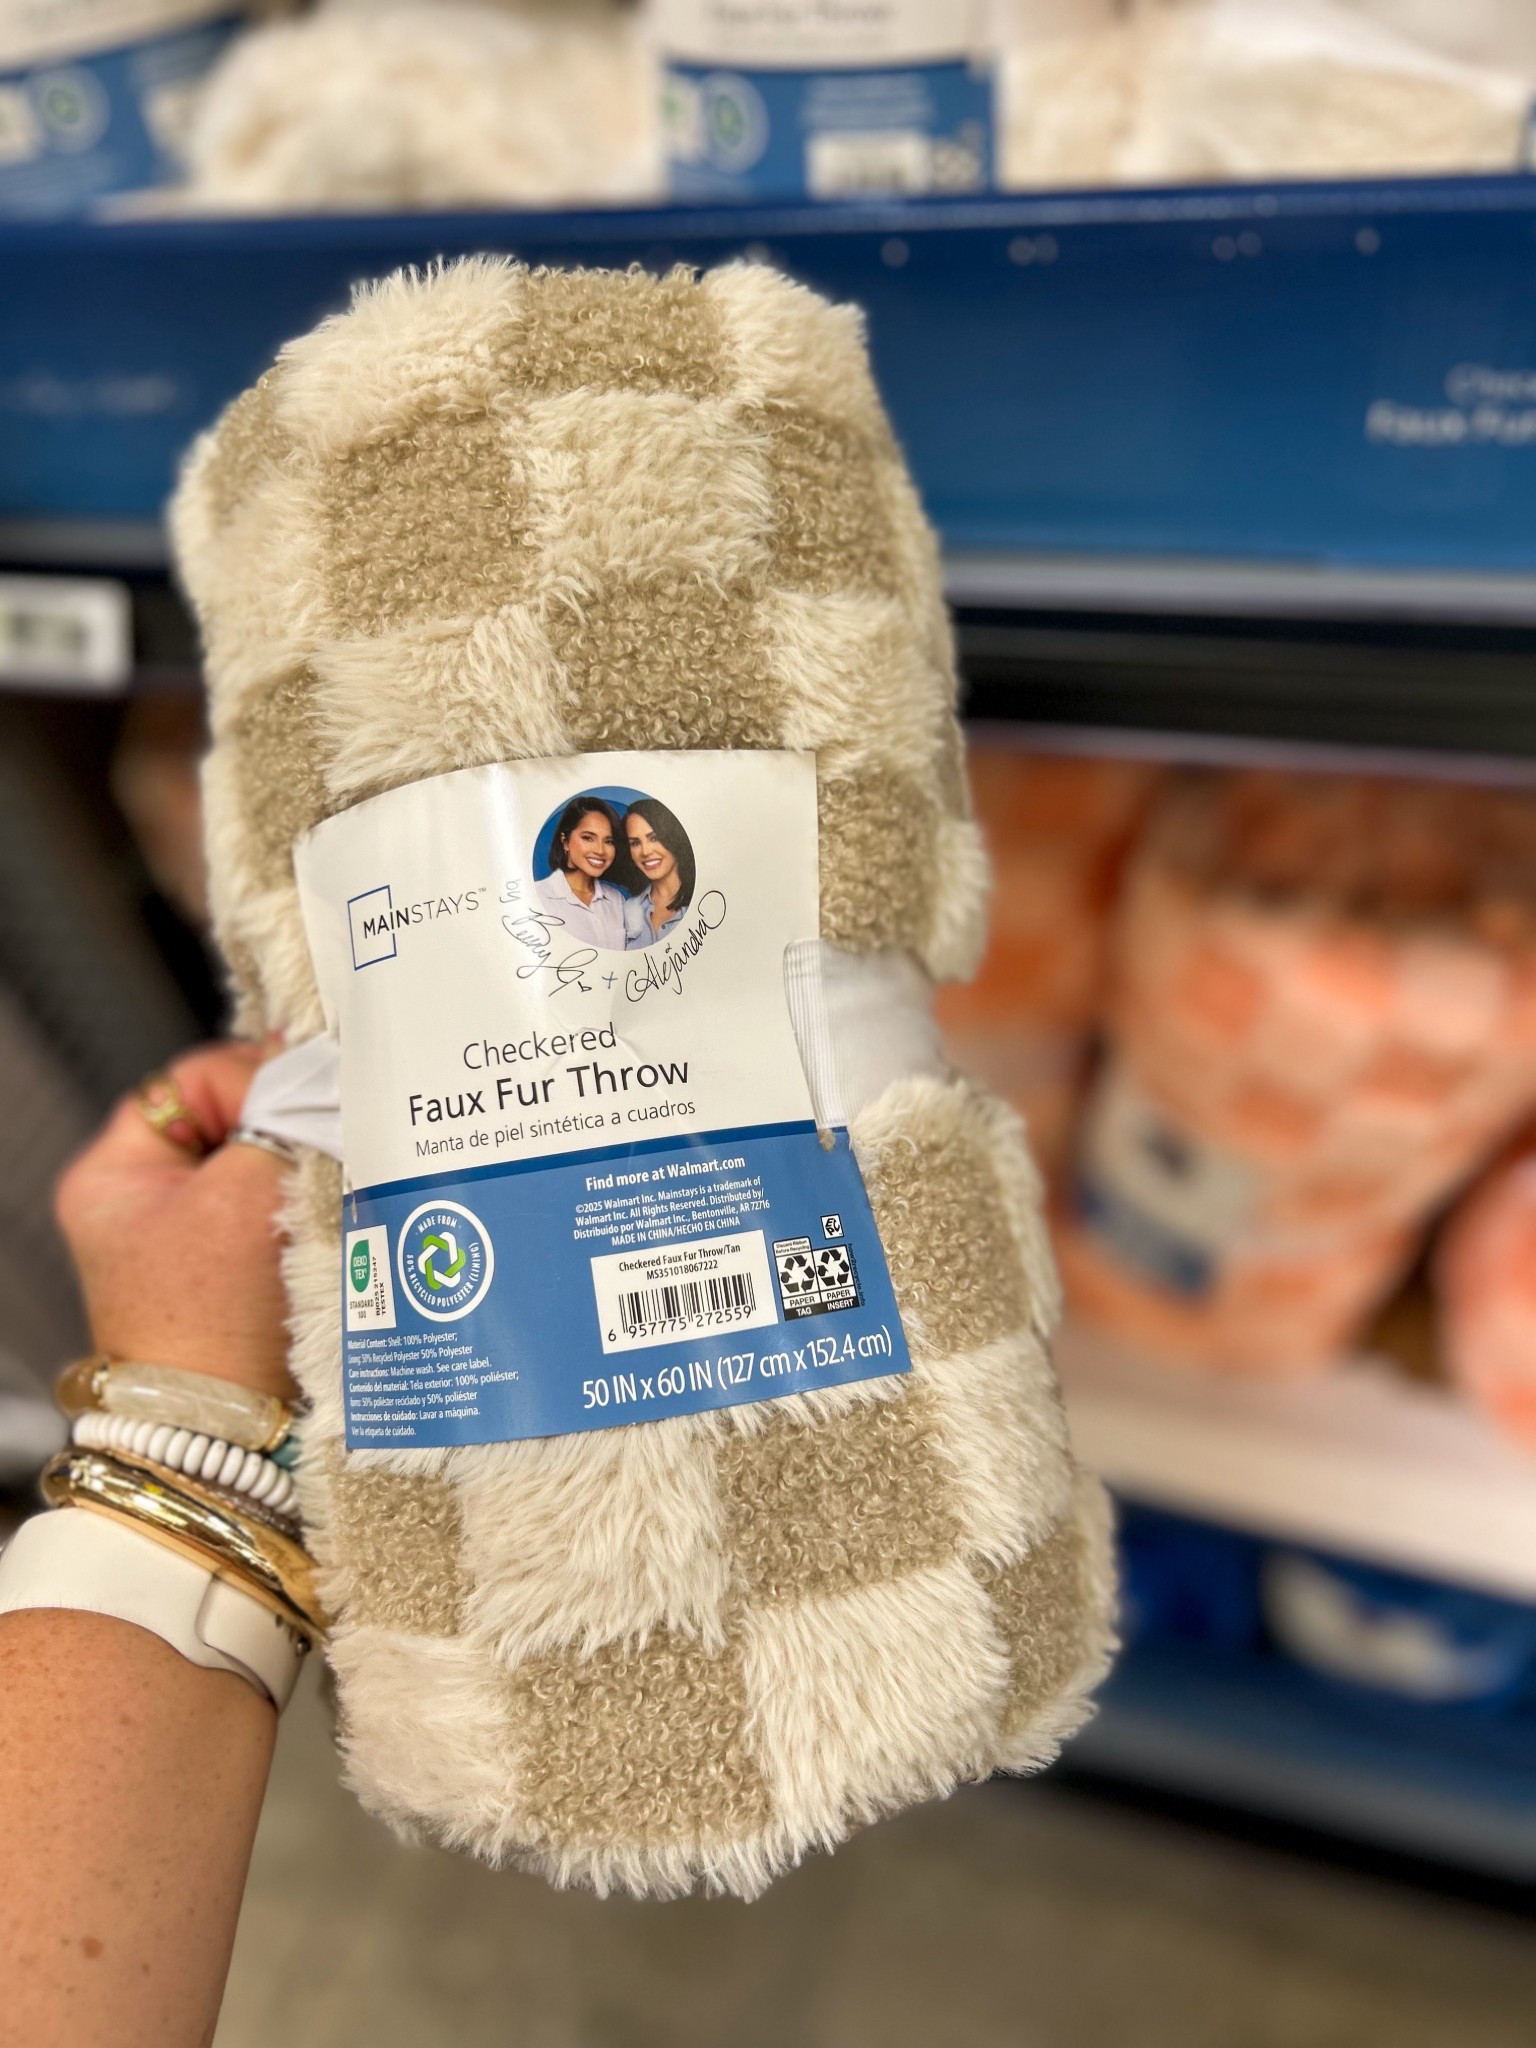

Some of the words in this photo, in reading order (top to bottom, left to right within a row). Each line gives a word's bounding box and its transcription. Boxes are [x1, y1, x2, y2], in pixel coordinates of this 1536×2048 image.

[625, 890, 726, 1002] Alejandra
[463, 1022, 616, 1069] Checkered
[409, 1090, 486, 1125] Faux
[496, 1076, 555, 1110] Fur
[567, 1061, 689, 1097] Throw
[416, 1137, 464, 1156] Manta
[469, 1130, 489, 1147] de
[495, 1123, 524, 1147] piel
[530, 1113, 604, 1138] sintética
[611, 1112, 621, 1124] a
[627, 1100, 696, 1122] cuadros
[586, 1174, 613, 1191] Find
[616, 1170, 649, 1187] more
[651, 1168, 665, 1180] at
[666, 1157, 745, 1178] Walmart.com
[575, 1202, 603, 1214] ©2025
[604, 1196, 640, 1209] Walmart
[641, 1194, 656, 1203] Inc.
[658, 1188, 699, 1202] Mainstays
[699, 1185, 706, 1194] is
[713, 1178, 752, 1192] trademark
[753, 1176, 761, 1186] of
[575, 1213, 612, 1227] Walmart
[613, 1211, 629, 1220] Inc.
[630, 1207, 641, 1217] All
[643, 1204, 668, 1217] Rights
[670, 1199, 708, 1211] Reserved.
[710, 1191, 751, 1205] Distributed
[753, 1188, 764, 1199] by/
[418, 1216, 436, 1233] MADE
[437, 1215, 457, 1228] FROM
[573, 1225, 619, 1239] Distribuido
[621, 1224, 634, 1234] por
[636, 1217, 671, 1229] Walmart
[672, 1213, 690, 1224] Inc.,
[692, 1205, 739, 1220] Bentonville,
[740, 1202, 750, 1212] AR
[750, 1200, 770, 1211] 72716
[611, 1235, 636, 1246] MADE
[637, 1232, 646, 1242] IN
[648, 1223, 704, 1240] CHINA/HECHO
[705, 1220, 715, 1231] EN
[716, 1217, 741, 1229] CHINA
[619, 1257, 661, 1272] Checkered
[663, 1255, 683, 1265] Faux
[684, 1251, 697, 1262] Fur
[698, 1243, 741, 1259] Throw/Tan
[409, 1273, 436, 1306] RECYCLED
[437, 1281, 474, 1307] POLYESTER
[468, 1242, 480, 1281] (LINING)
[646, 1259, 719, 1280] MS351018067222
[350, 1299, 374, 1309] STANDARD
[789, 1296, 815, 1307] PAPER
[826, 1289, 851, 1300] PAPER
[827, 1299, 854, 1311] INSERT
[796, 1307, 812, 1316] TAG
[608, 1329, 617, 1342] 6
[628, 1316, 687, 1338] 957775
[696, 1305, 751, 1327] 272559
[348, 1338, 366, 1349] Material
[403, 1335, 422, 1345] 100%
[423, 1332, 458, 1345] Polyester;
[372, 1353, 393, 1365] Recycled
[394, 1350, 419, 1364] Polyester
[421, 1348, 438, 1359] 50%
[439, 1345, 473, 1358] Polyester
[349, 1368, 359, 1378] Care
[390, 1364, 415, 1376] Machine
[415, 1364, 435, 1374] wash.
[436, 1362, 450, 1373] See
[451, 1362, 468, 1371] care
[469, 1357, 492, 1369] label.
[582, 1378, 609, 1409] 50
[612, 1373, 637, 1404] IN
[640, 1379, 655, 1400] x
[657, 1365, 685, 1396] 60
[688, 1361, 712, 1391] IN
[717, 1352, 755, 1390] (127
[759, 1355, 791, 1378] cm
[795, 1350, 807, 1371] x
[806, 1333, 855, 1368] 152.4
[857, 1325, 892, 1357] cm)
[349, 1381, 373, 1393] Contenido
[374, 1381, 383, 1392] del
[383, 1379, 409, 1391] material:
[410, 1379, 423, 1390] Tela
[424, 1377, 453, 1389] exterior:
[455, 1375, 478, 1386] 100%
[480, 1371, 519, 1386] poliéster;
[395, 1395, 421, 1406] reciclado
[421, 1398, 426, 1407] y
[427, 1393, 443, 1404] 50%
[444, 1390, 477, 1404] poliéster
[351, 1410, 383, 1422] Instrucciones
[383, 1411, 391, 1421] de
[391, 1410, 418, 1421] cuidado:
[419, 1409, 438, 1420] Lavar
[439, 1411, 443, 1419] a
[445, 1406, 481, 1419] máquina.
[359, 1426, 364, 1436] la
[364, 1425, 384, 1439] etiqueta
[385, 1425, 391, 1436] de
[392, 1425, 416, 1436] cuidado.
